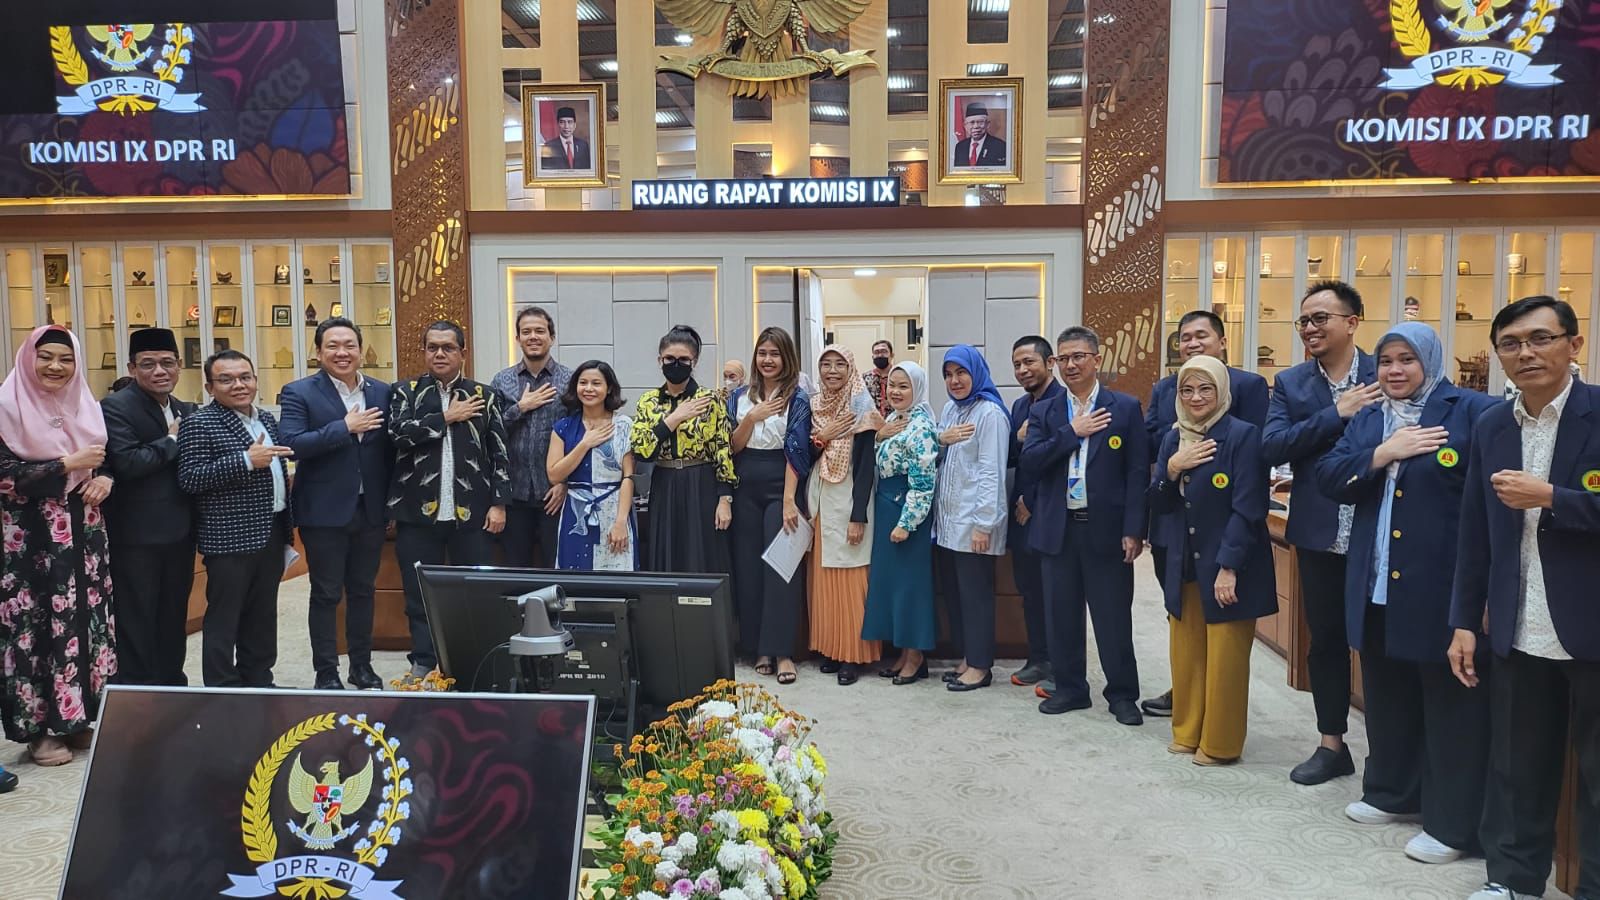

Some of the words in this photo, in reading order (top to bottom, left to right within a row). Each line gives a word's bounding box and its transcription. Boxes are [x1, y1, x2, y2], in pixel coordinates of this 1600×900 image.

[1429, 49, 1474, 70] DPR
[1492, 50, 1515, 68] RI
[90, 78, 128, 98] DPR
[143, 79, 161, 97] RI
[1346, 117, 1450, 143] KOMISI
[1456, 116, 1487, 141] IX
[1493, 115, 1554, 140] DPR
[1559, 114, 1590, 139] RI
[29, 140, 118, 164] KOMISI
[124, 140, 149, 162] IX
[154, 139, 206, 162] DPR
[212, 138, 236, 161] RI
[633, 182, 709, 205] RUANG
[714, 181, 784, 205] RAPAT
[789, 180, 866, 204] KOMISI
[872, 179, 896, 203] IX
[274, 857, 318, 879] DPR
[335, 861, 358, 882] RI
